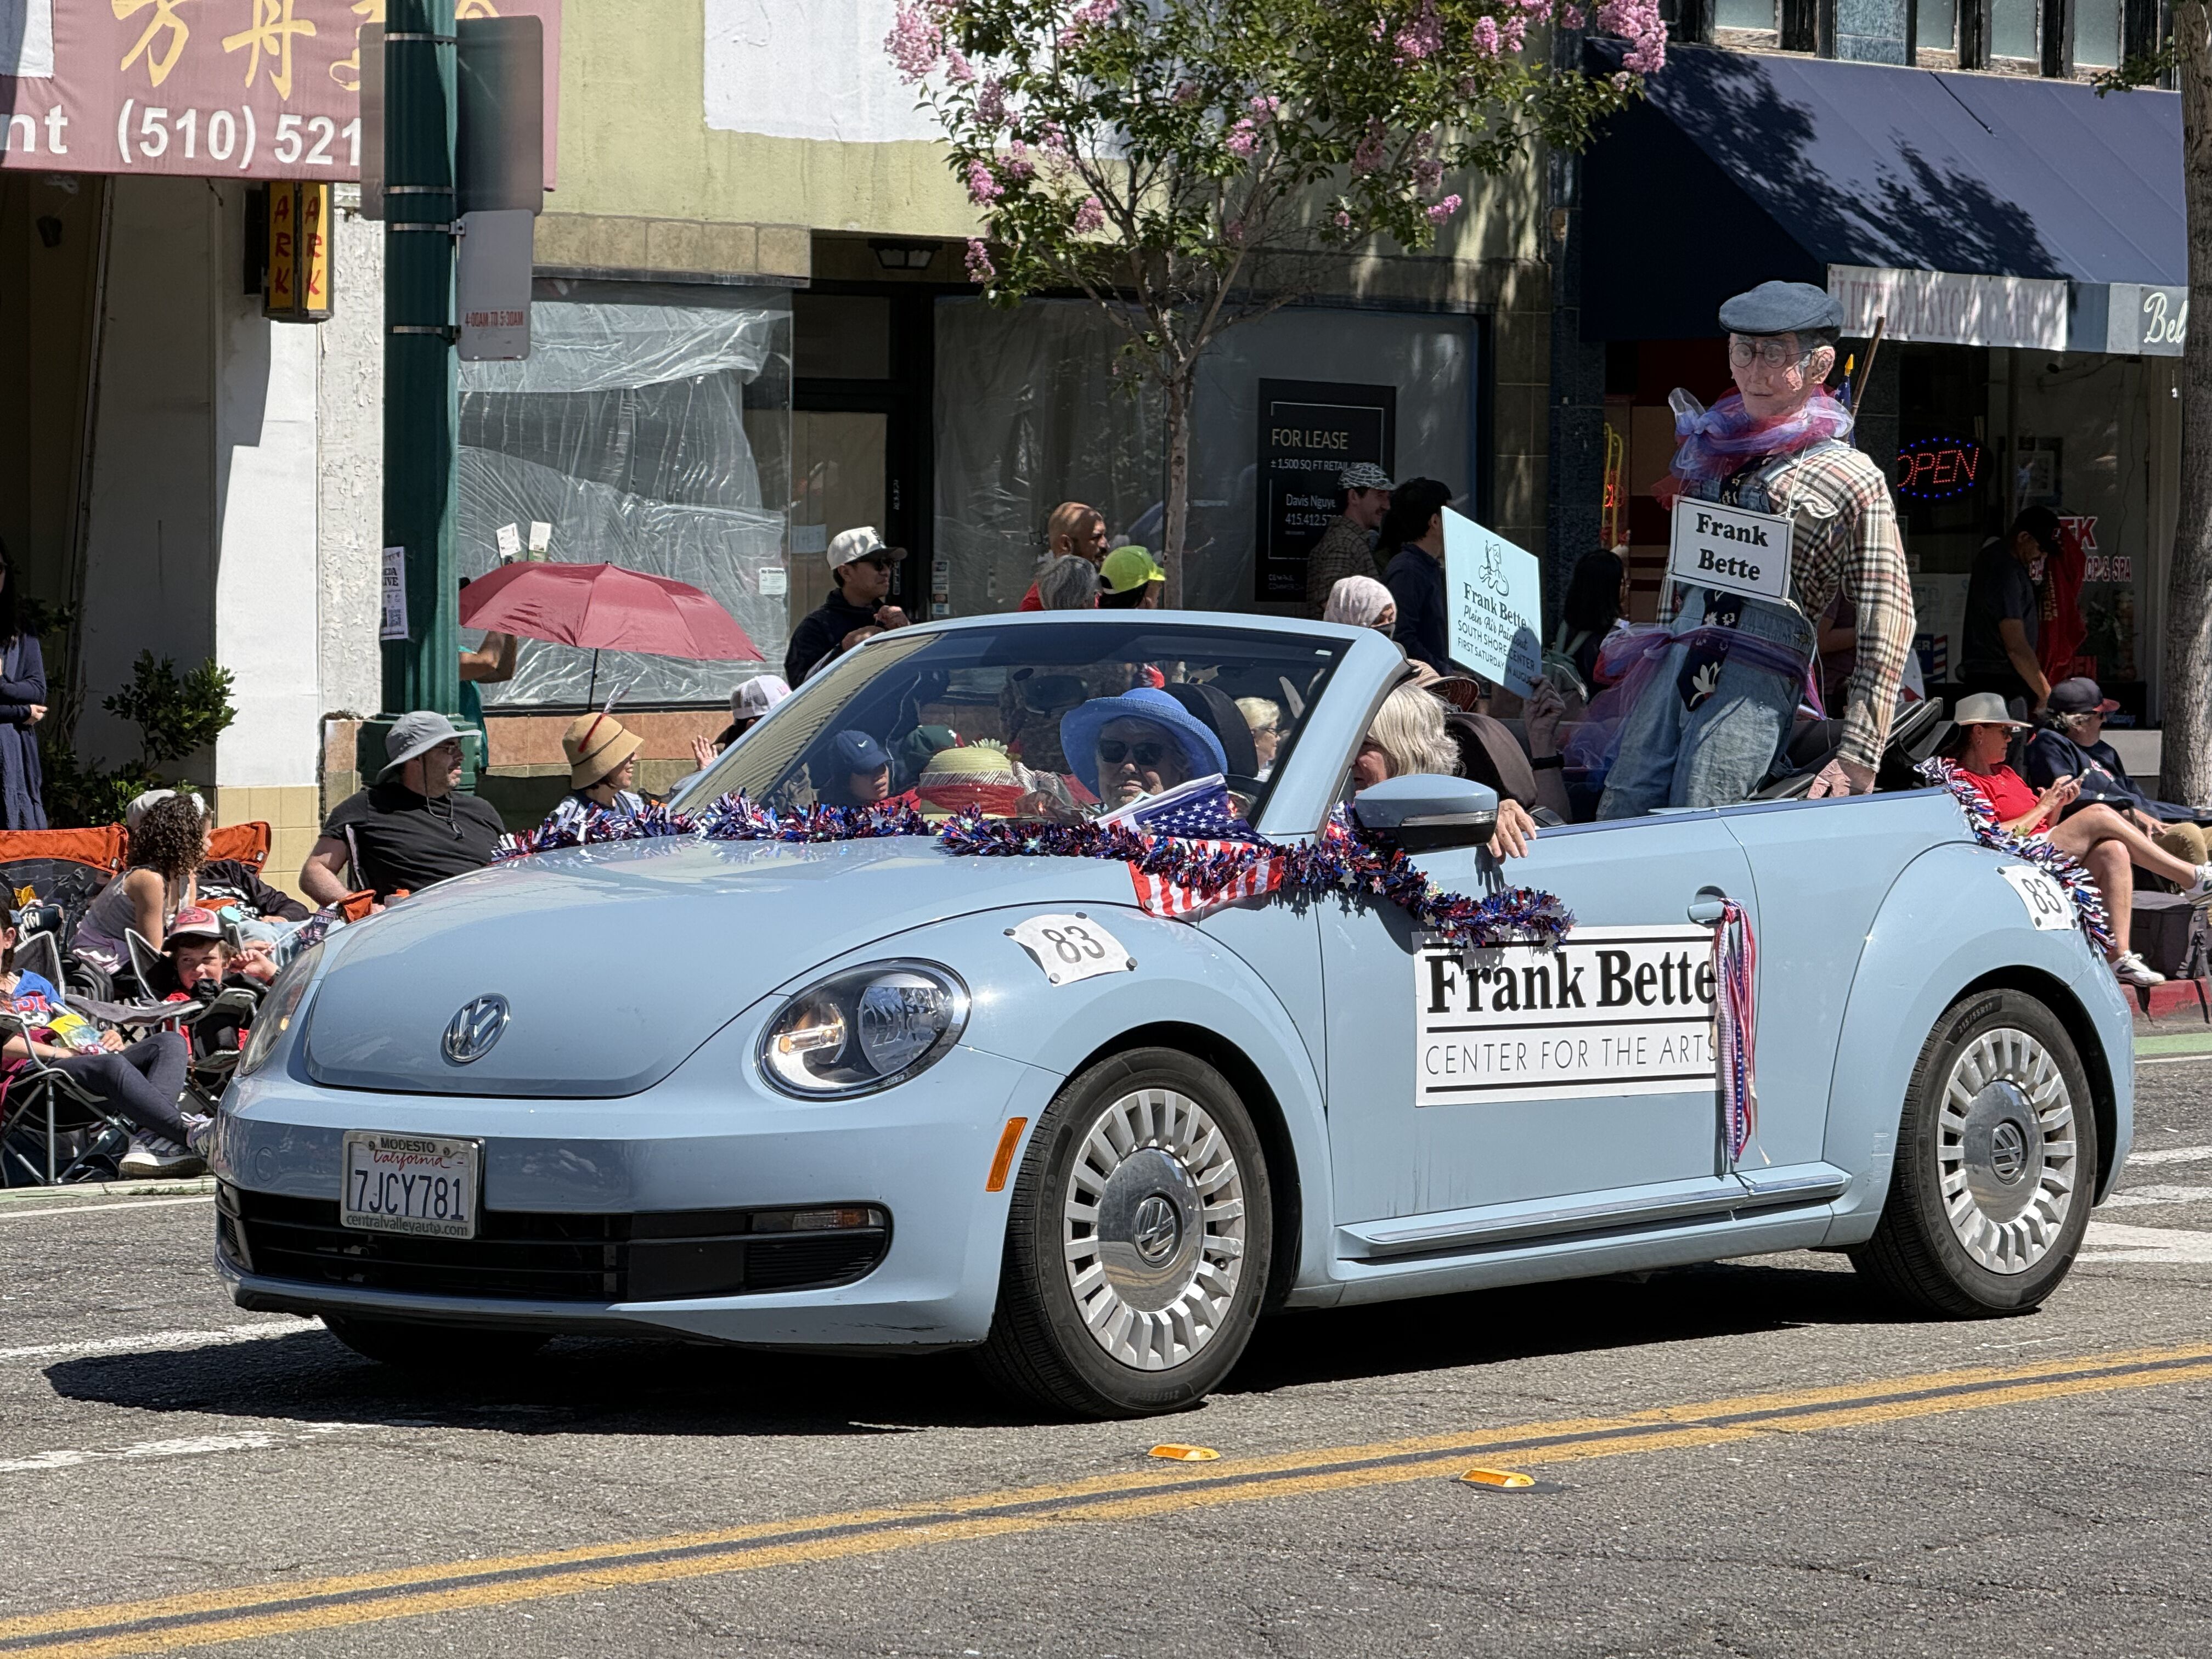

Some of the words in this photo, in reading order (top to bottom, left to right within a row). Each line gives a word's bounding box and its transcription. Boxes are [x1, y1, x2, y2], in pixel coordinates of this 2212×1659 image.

[117, 99, 256, 169] (510)
[274, 195, 291, 295] ARK
[305, 196, 322, 295] ARK
[490, 311, 498, 326] TO
[1272, 428, 1302, 447] FOR
[1305, 430, 1349, 450] LEASE
[1278, 458, 1299, 470] 1,500
[1300, 459, 1311, 472] SQ
[1313, 461, 1323, 470] FT
[1324, 461, 1347, 471] RETAIL
[1897, 447, 1979, 487] OPEN
[1286, 494, 1308, 506] Davis
[1696, 512, 1768, 547] Frank
[1698, 548, 1760, 580] Bette
[2112, 556, 2132, 582] SPA
[1463, 582, 1497, 616] Frank
[1499, 601, 1526, 631] Bette
[1464, 605, 1482, 625] Plein
[1484, 616, 1497, 634] Air
[1458, 619, 1482, 642] SOUTH
[1484, 634, 1508, 657] SHORE
[1509, 648, 1534, 672] CENTER
[1458, 637, 1474, 653] FIRST
[1475, 646, 1504, 670] SATURDAY
[2021, 878, 2062, 915] 83
[1042, 926, 1105, 963] 83
[1425, 950, 1586, 1014] Frank
[1595, 949, 1717, 1007] Bette
[1426, 1041, 1527, 1075] CENTER
[1541, 1039, 1588, 1070] FOR
[1601, 1036, 1646, 1067] THE
[374, 1149, 451, 1171] California
[381, 1137, 436, 1154] MODESTO
[354, 1169, 465, 1221] 7JCY781
[346, 1213, 467, 1237] centralvalleyauto.com
